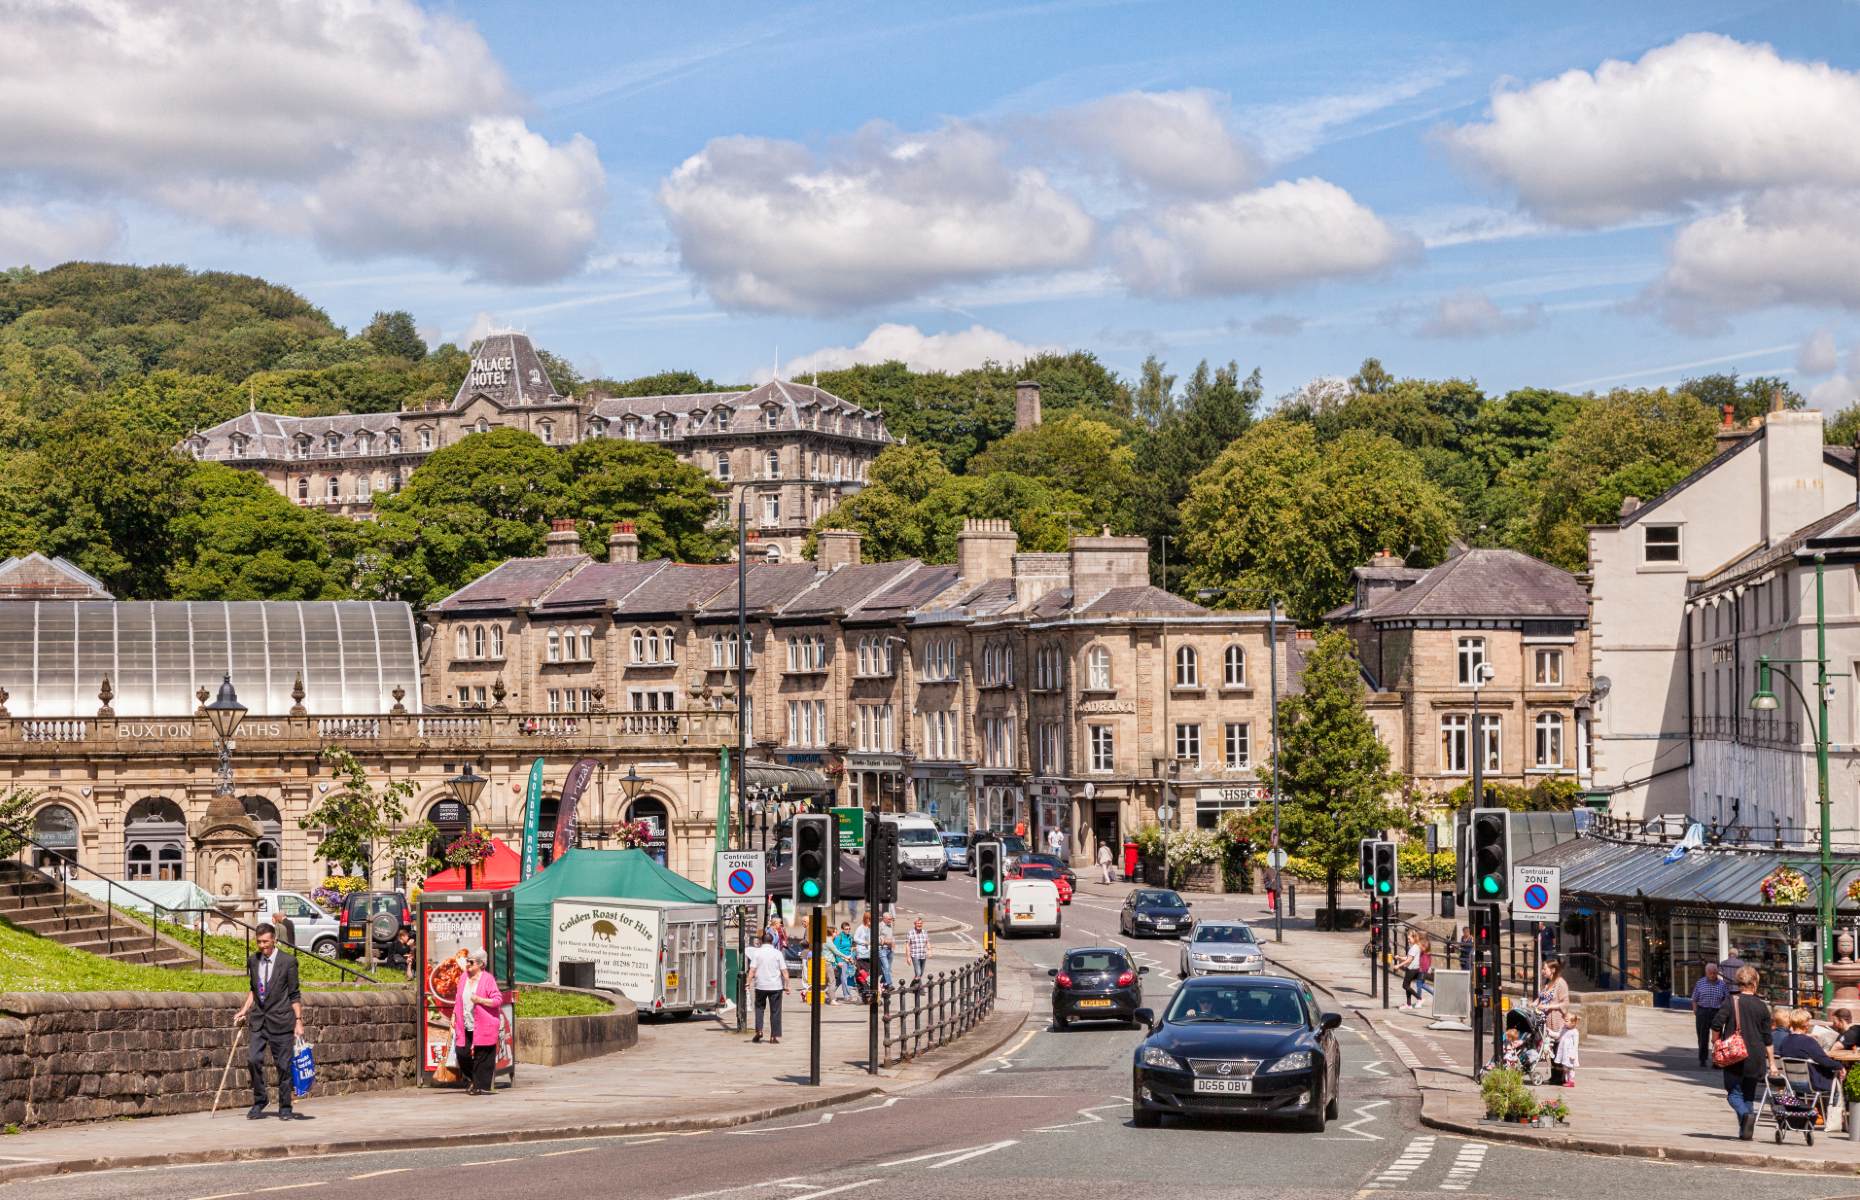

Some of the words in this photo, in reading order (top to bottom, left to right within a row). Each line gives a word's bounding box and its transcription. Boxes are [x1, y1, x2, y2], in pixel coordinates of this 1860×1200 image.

[471, 357, 511, 371] PALACE
[471, 371, 507, 386] HOTEL
[118, 724, 192, 737] BUXTON
[234, 724, 281, 737] ATHS
[528, 772, 537, 829] GOLDEN
[1224, 789, 1255, 800] HSBC
[525, 835, 533, 881] ROAST
[1525, 876, 1549, 884] ZONE
[559, 912, 591, 932] Golden
[592, 909, 618, 921] Roast
[619, 912, 635, 926] for
[634, 920, 653, 940] Hire
[1198, 1080, 1225, 1090] DG56
[1227, 1081, 1247, 1092] OBV
